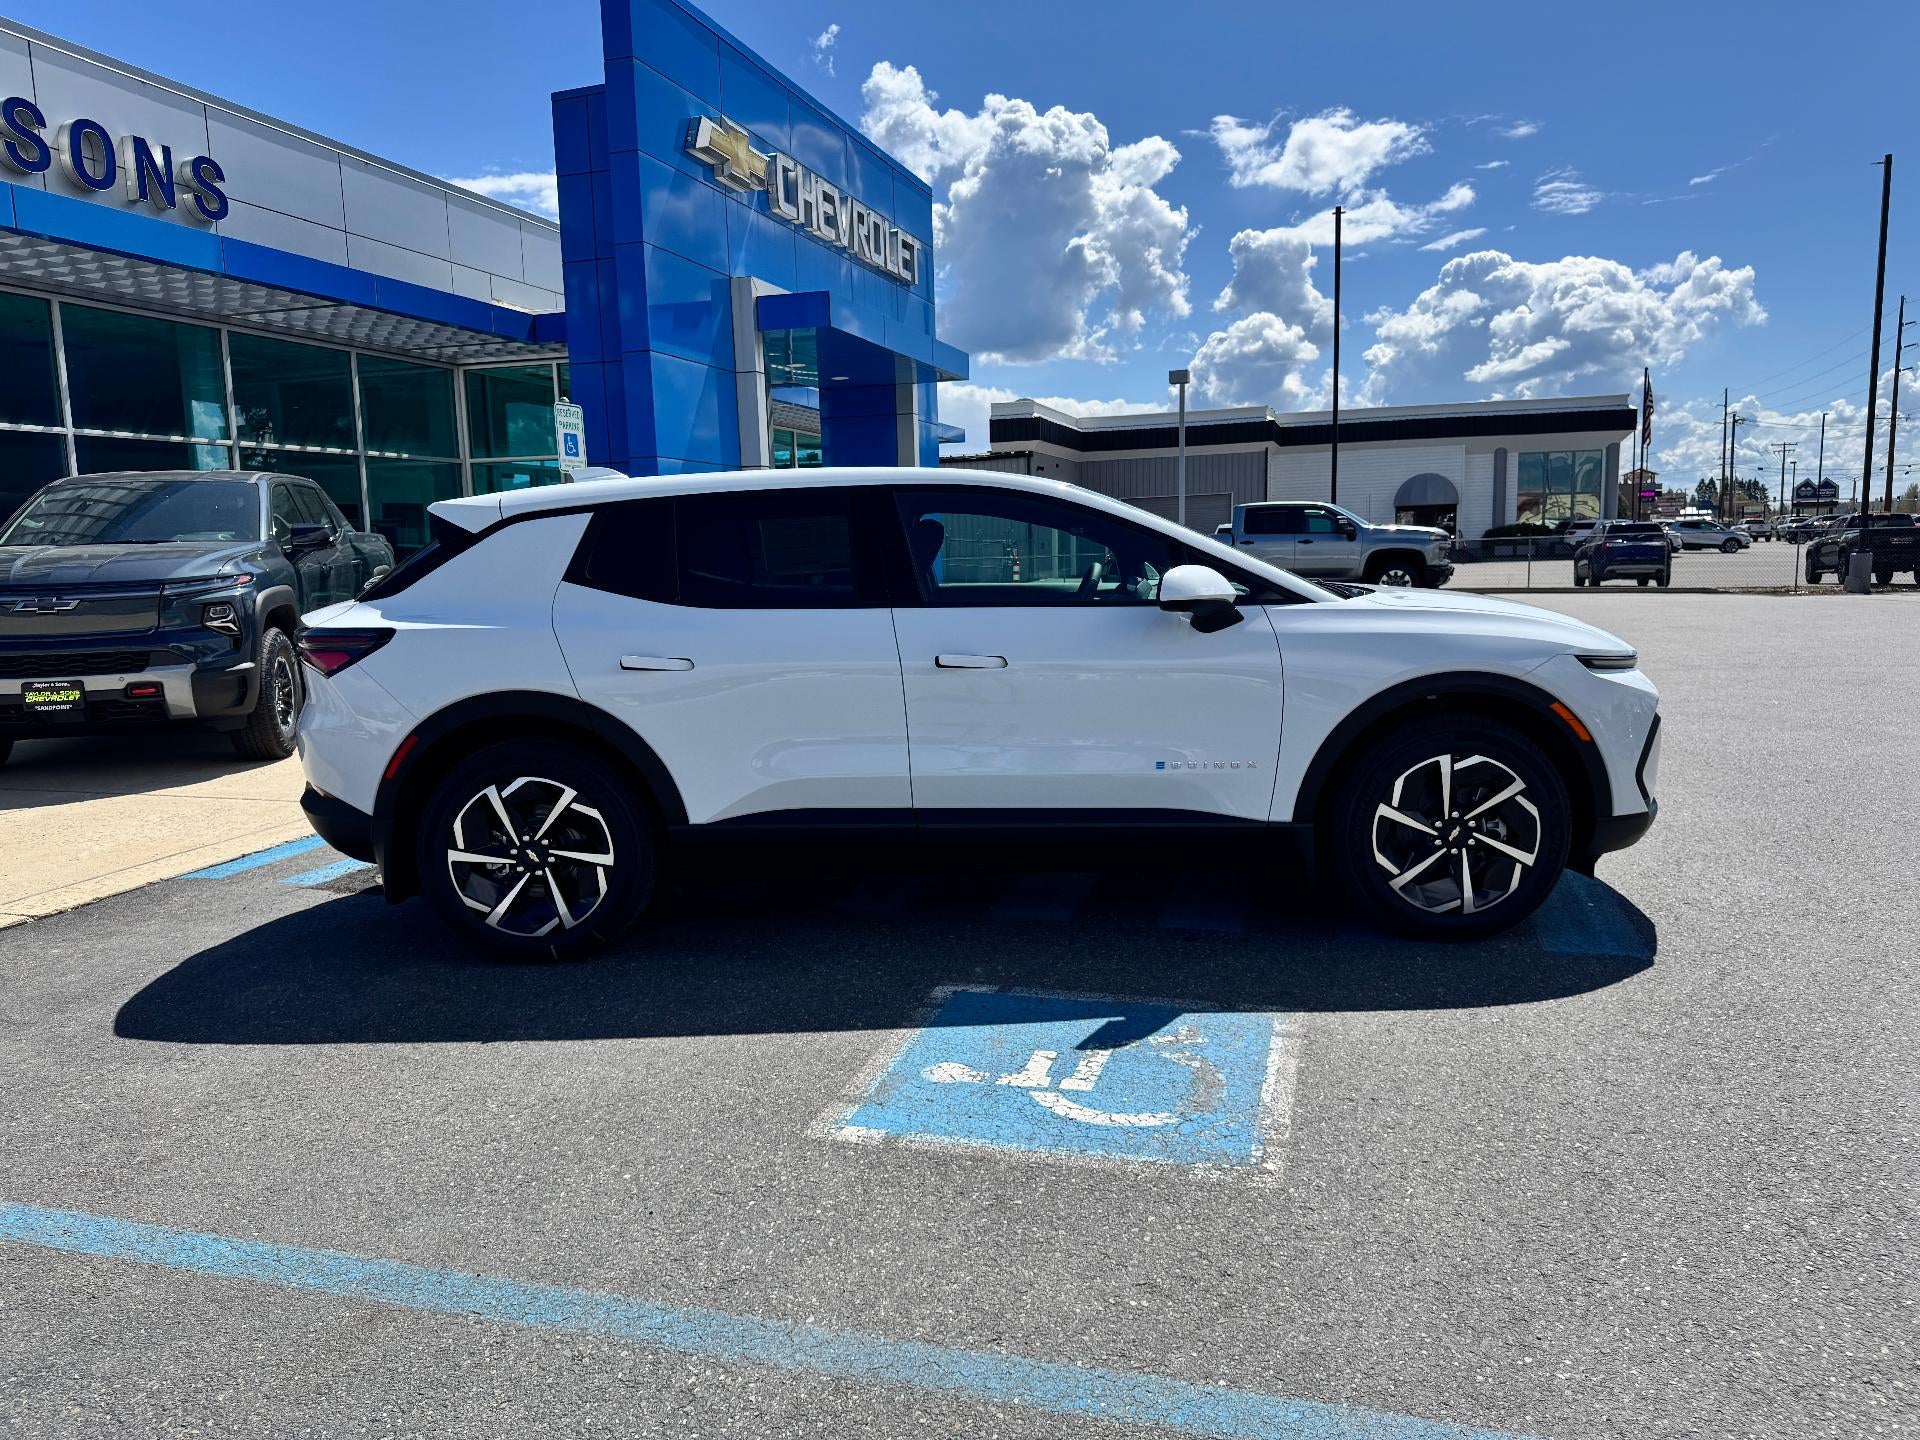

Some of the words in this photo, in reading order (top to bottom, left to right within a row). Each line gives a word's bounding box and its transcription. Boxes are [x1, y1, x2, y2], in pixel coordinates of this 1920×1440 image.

[0, 96, 229, 222] SONS
[767, 152, 921, 285] CHEVROLET
[556, 408, 580, 420] RESERVED
[558, 420, 580, 431] PARKING
[25, 694, 80, 703] CHEVROLET
